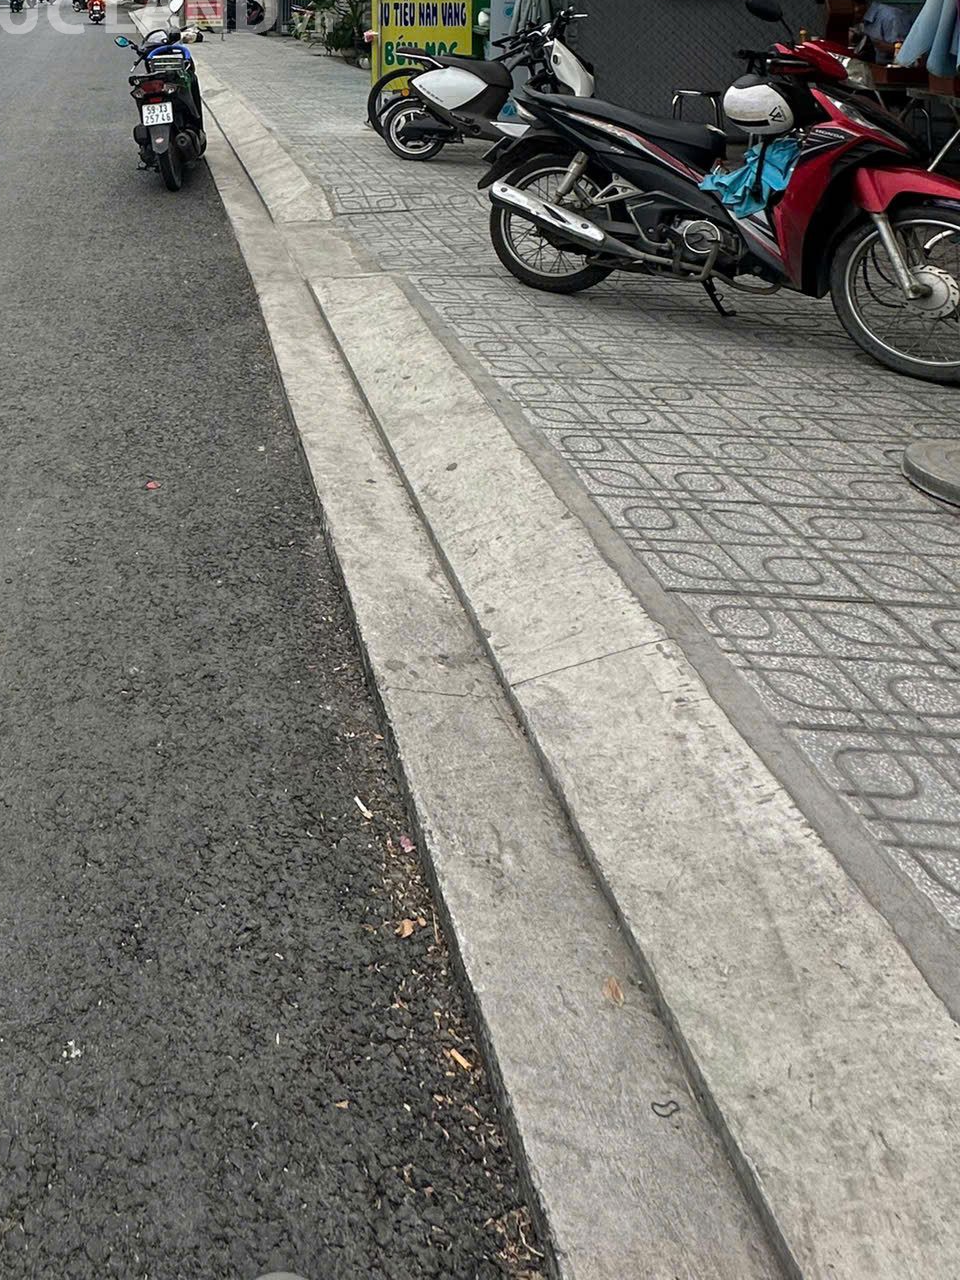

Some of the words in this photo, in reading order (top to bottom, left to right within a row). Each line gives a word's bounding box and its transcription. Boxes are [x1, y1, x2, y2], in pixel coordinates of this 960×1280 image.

[419, 2, 438, 27] NAM
[441, 2, 467, 27] VANG
[815, 128, 846, 140] HONDA
